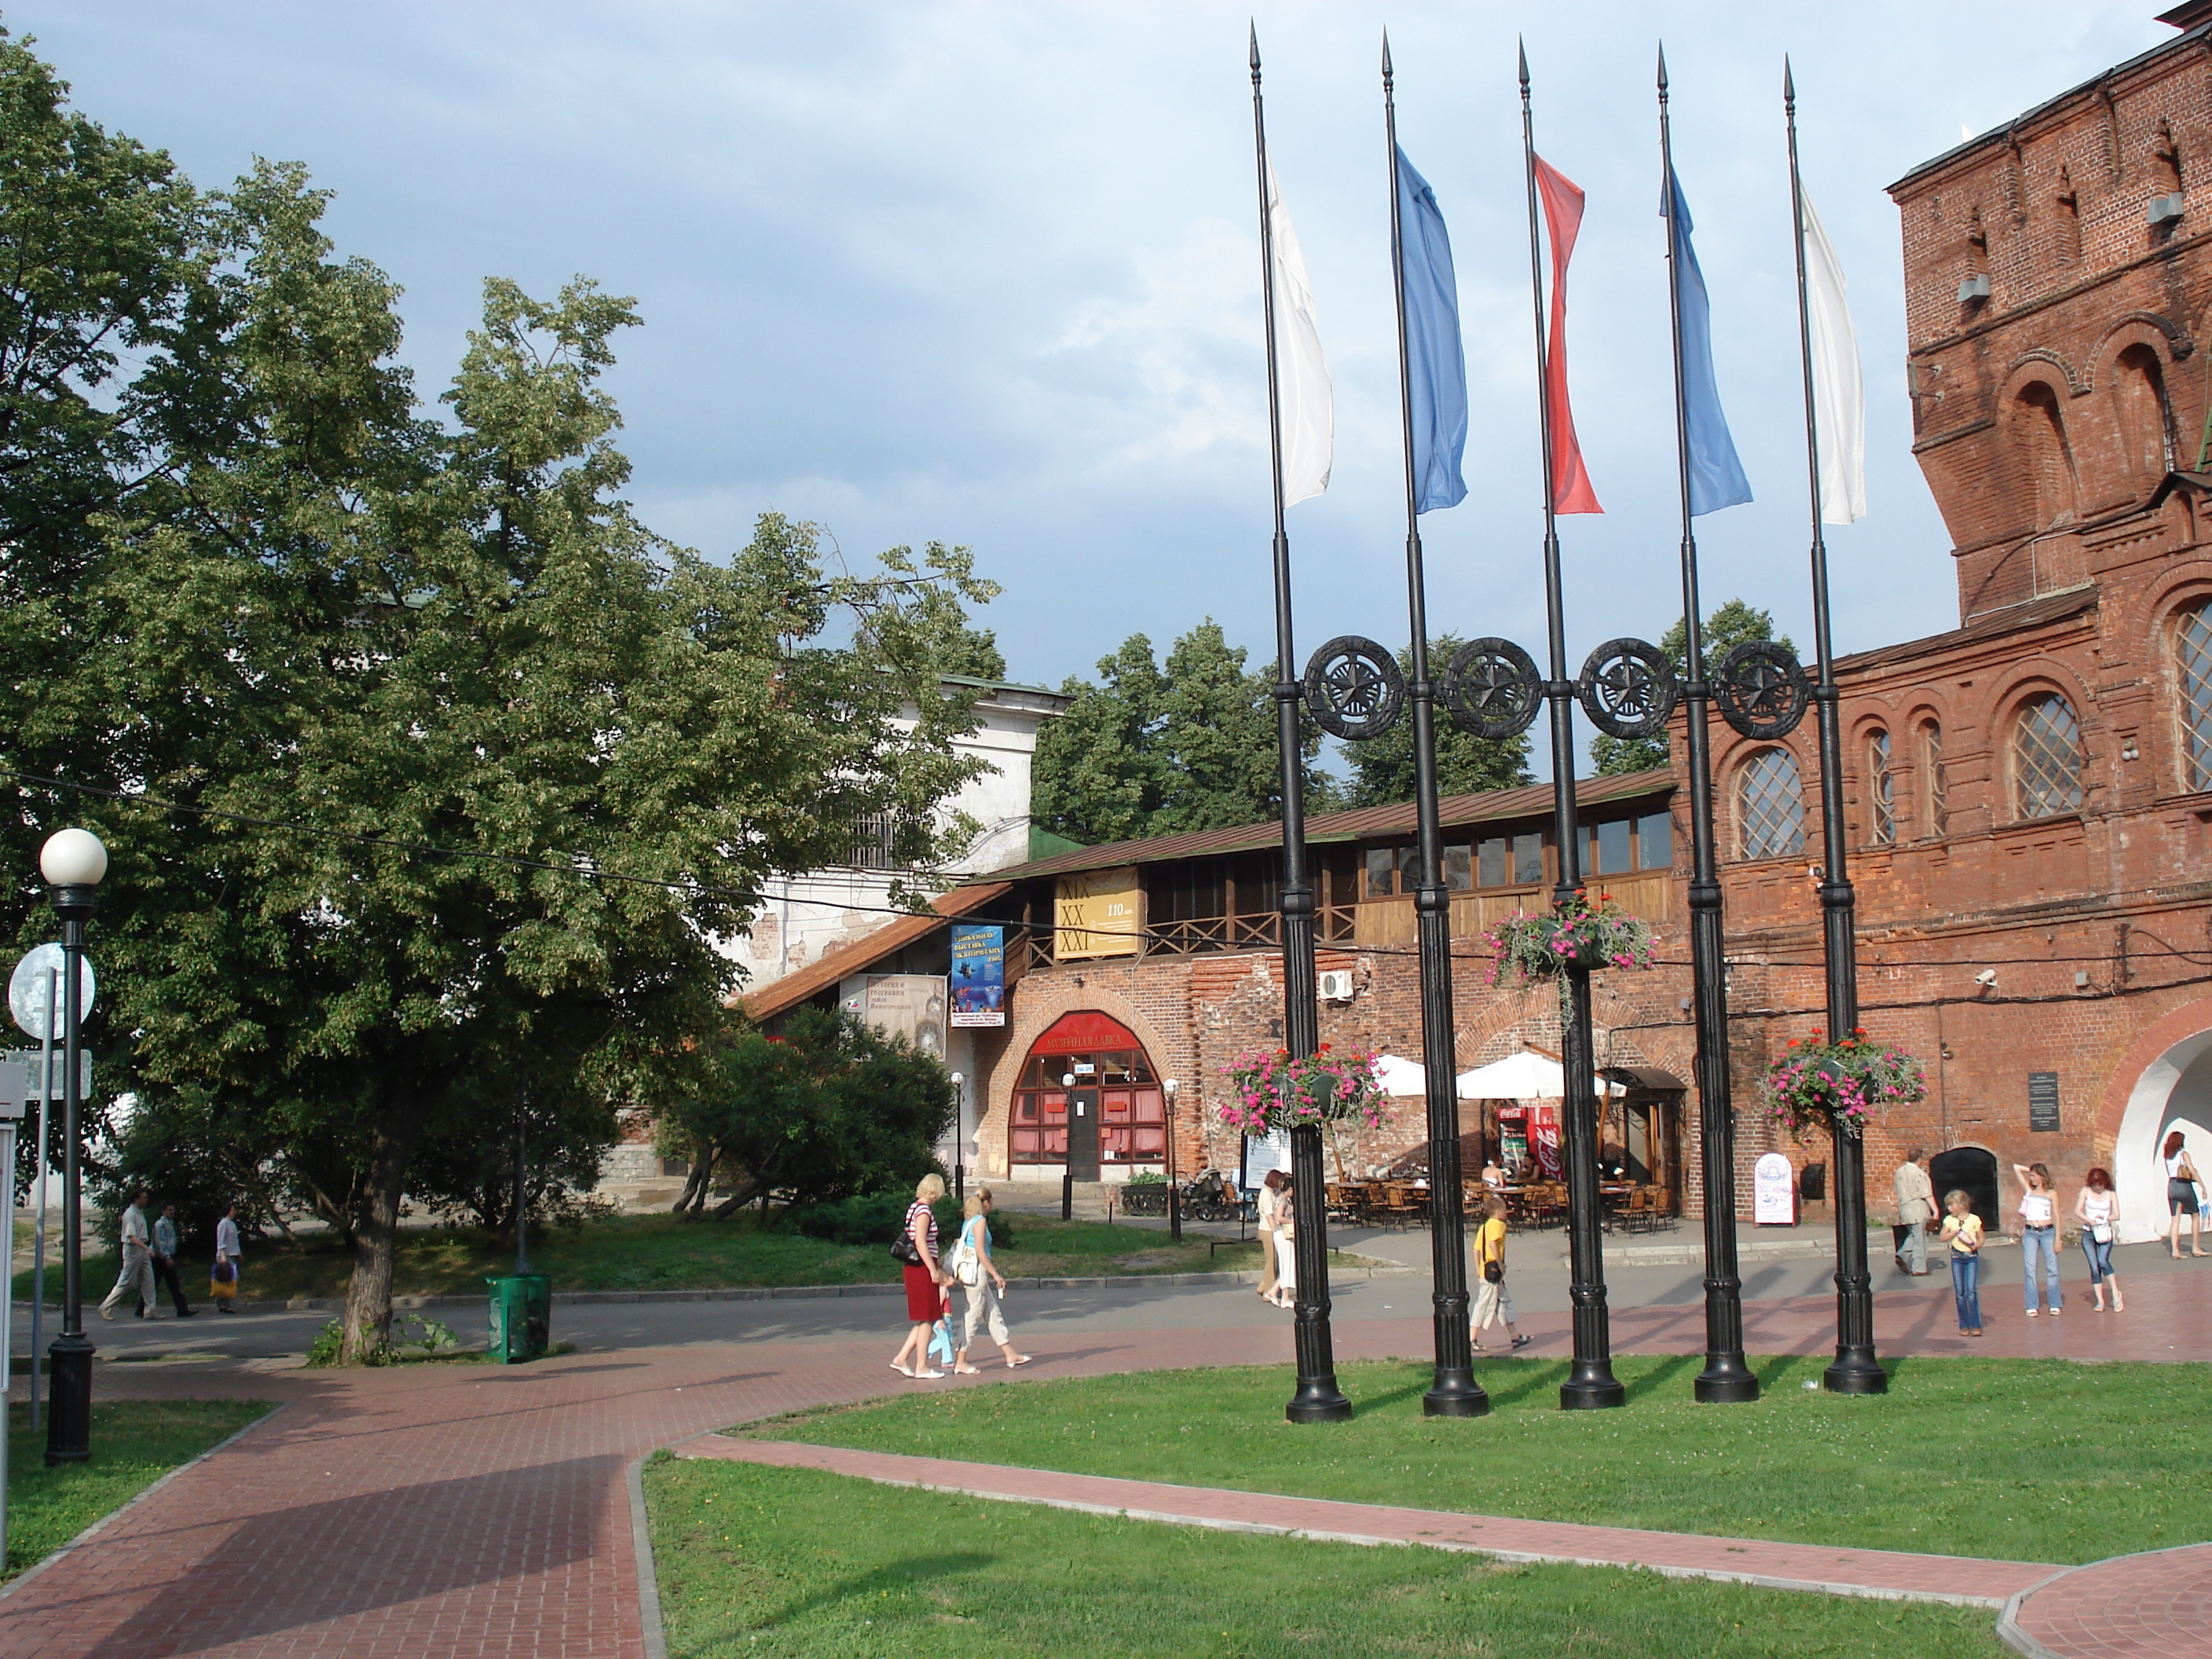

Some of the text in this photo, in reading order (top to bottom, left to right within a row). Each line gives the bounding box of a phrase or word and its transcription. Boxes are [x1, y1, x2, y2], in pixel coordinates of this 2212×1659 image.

[1061, 878, 1090, 900] XIX
[1061, 904, 1084, 926] XX
[1108, 903, 1123, 917] 110
[1060, 931, 1089, 952] XXI
[1047, 1034, 1122, 1049] МУЗЕЙНАЯ ЛАВКА
[1500, 1108, 1522, 1119] Coca-Cola
